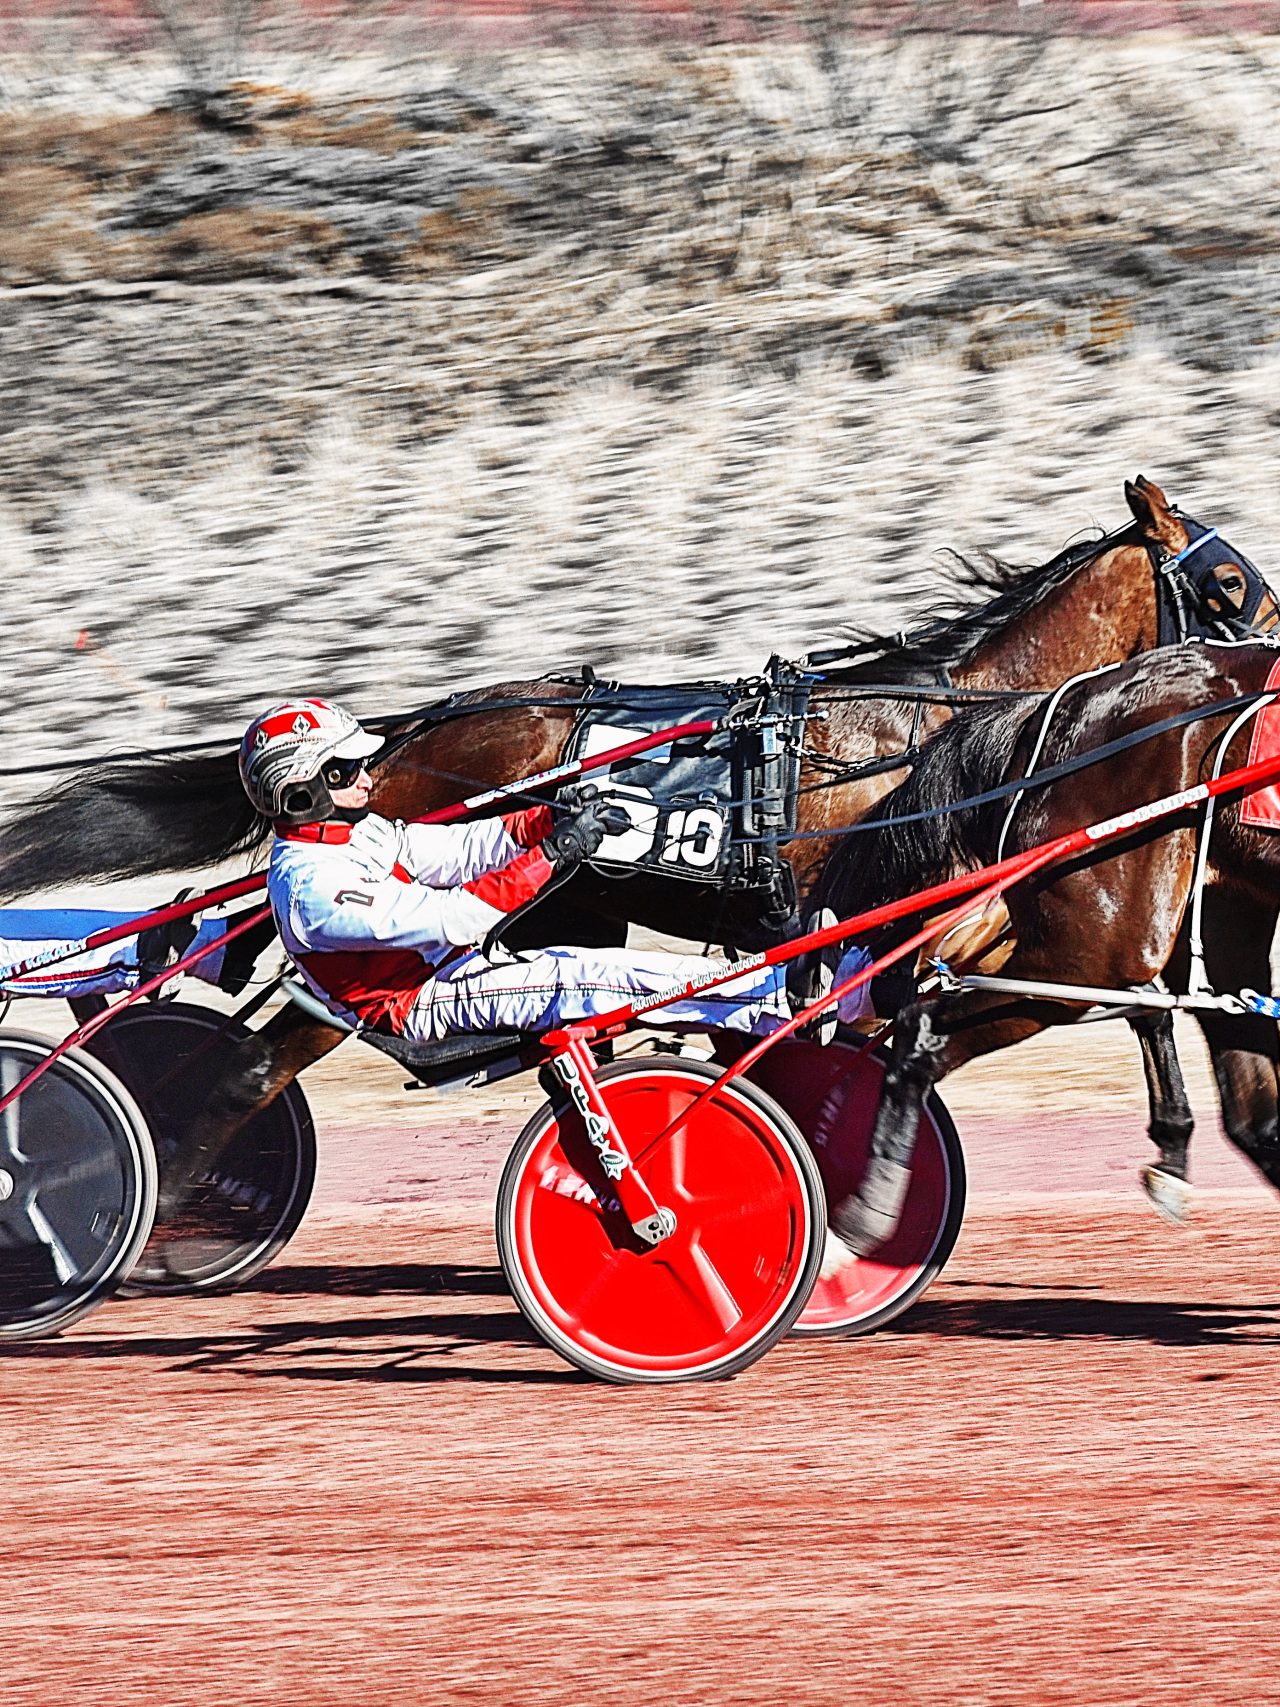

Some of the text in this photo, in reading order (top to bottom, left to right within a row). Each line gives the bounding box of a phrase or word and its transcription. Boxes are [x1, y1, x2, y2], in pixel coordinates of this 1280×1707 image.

[1138, 786, 1208, 821] ECLIPSE
[662, 809, 723, 866] 10
[631, 952, 766, 1012] ANTHONY NAPOLITANO
